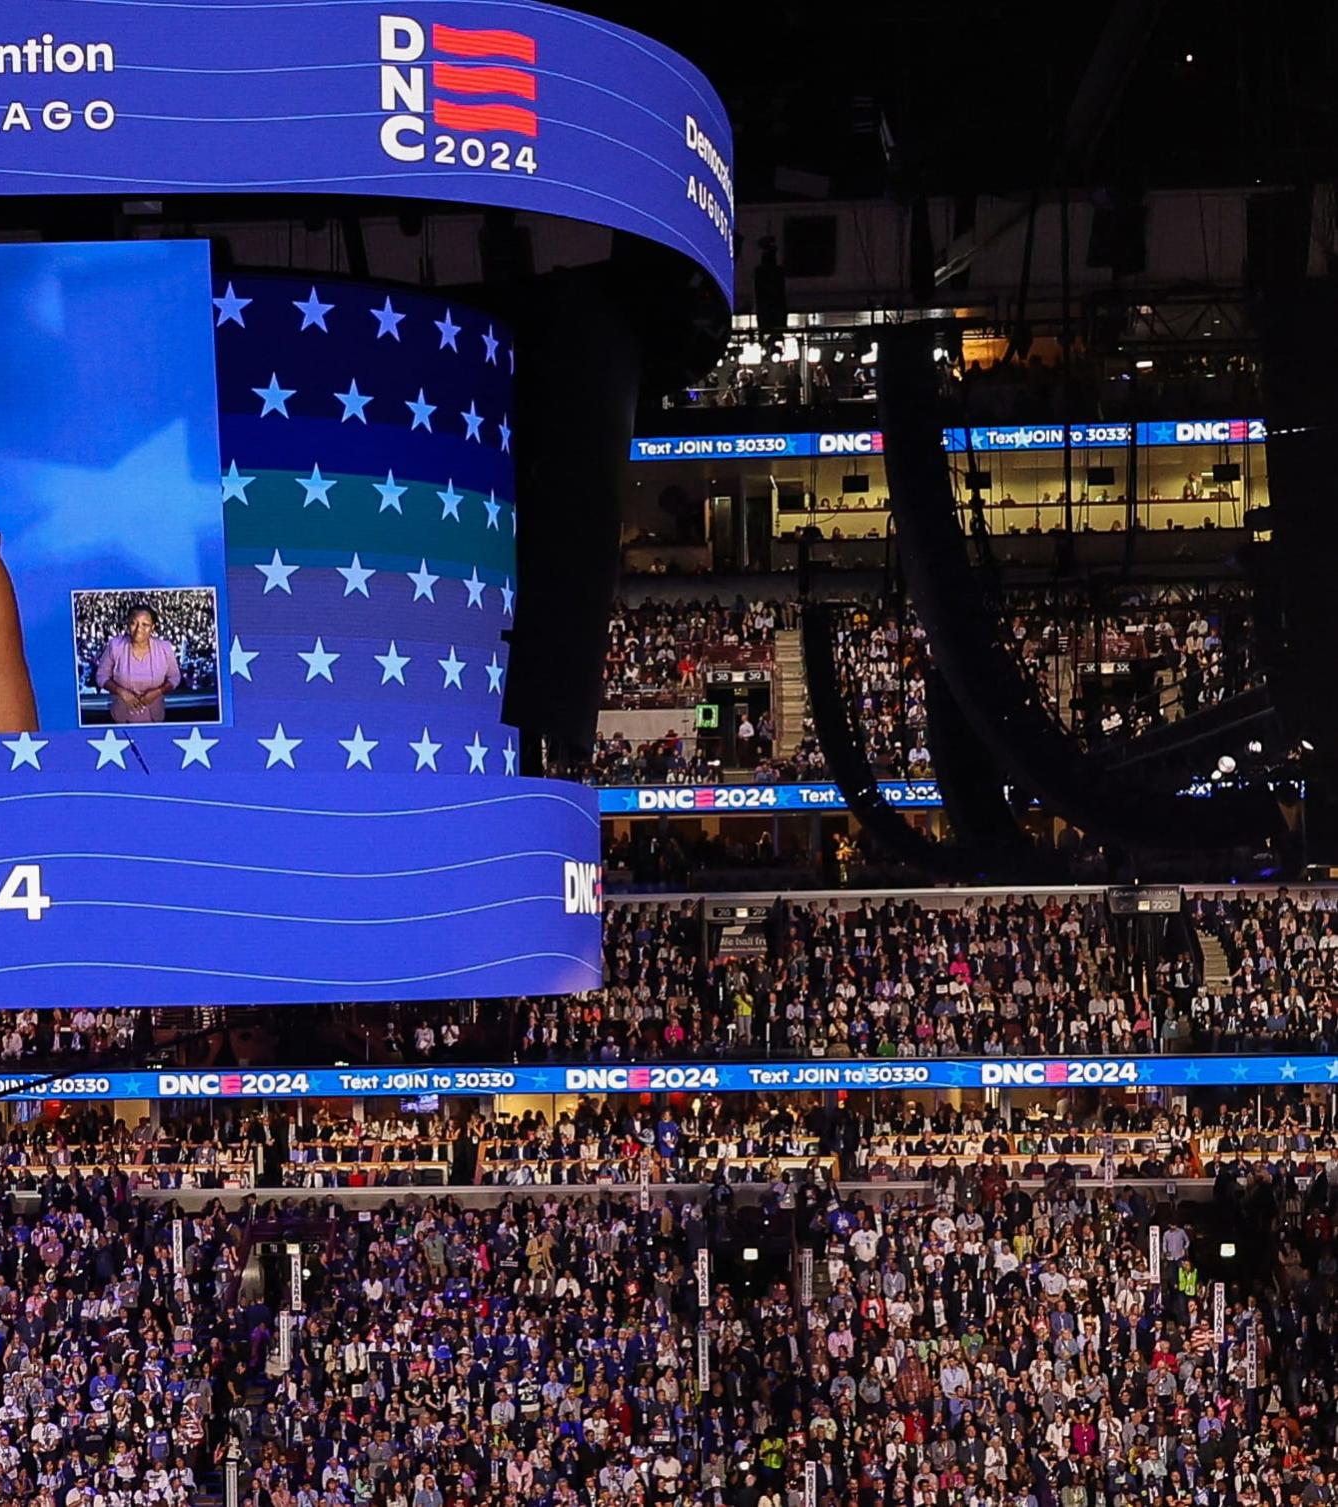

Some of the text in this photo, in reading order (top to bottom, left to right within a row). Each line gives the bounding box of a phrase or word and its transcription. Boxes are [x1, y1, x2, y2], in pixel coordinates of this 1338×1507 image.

[434, 135, 537, 174] 2024
[687, 176, 728, 241] AUGUST
[987, 431, 1019, 443] Text
[1177, 422, 1229, 441] DNC
[638, 438, 786, 455] Text JOIN to 30330
[820, 433, 871, 452] DNC
[638, 788, 777, 809] DNC 2024
[799, 789, 835, 803] Text
[885, 788, 902, 800] to
[564, 861, 597, 914] DNC
[340, 1073, 514, 1089] Text JOIN to 30330
[566, 1068, 718, 1089] DNC 2024
[749, 1067, 928, 1083] Text JOIN to 30330
[981, 1062, 1137, 1083] DNC 2024
[52, 1077, 110, 1093] 30330
[159, 1074, 309, 1094] DNC 2024
[292, 1260, 301, 1302] ALABAMA
[698, 1256, 708, 1299] ALASKA
[1215, 1290, 1224, 1335] MONTANA
[1247, 1336, 1258, 1380] MAINE
